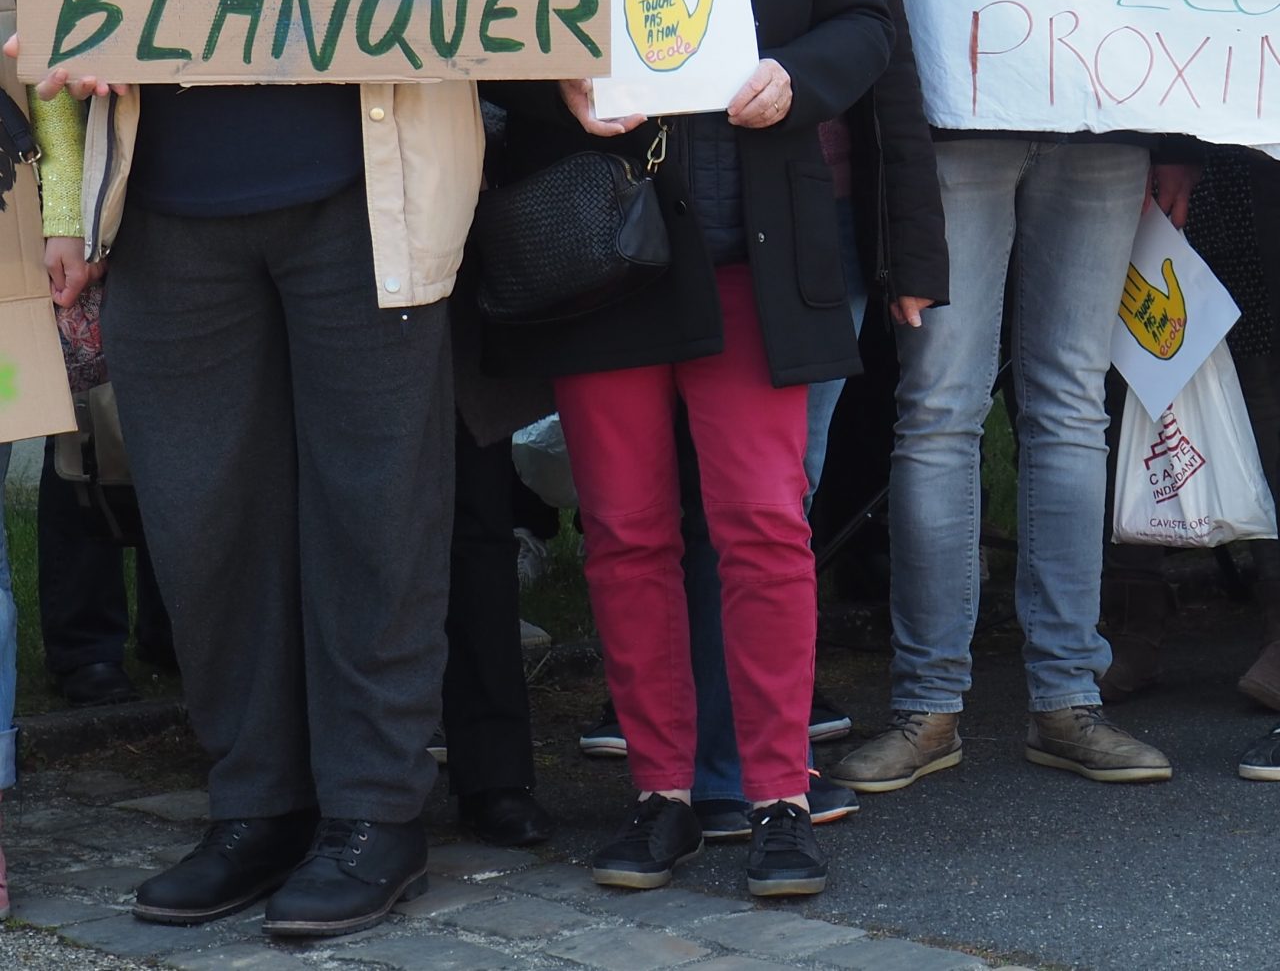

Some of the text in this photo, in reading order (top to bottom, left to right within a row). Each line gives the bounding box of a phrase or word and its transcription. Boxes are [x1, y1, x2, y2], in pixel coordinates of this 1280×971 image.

[644, 13, 663, 28] PAS
[656, 21, 680, 42] MON
[646, 35, 698, 64] école
